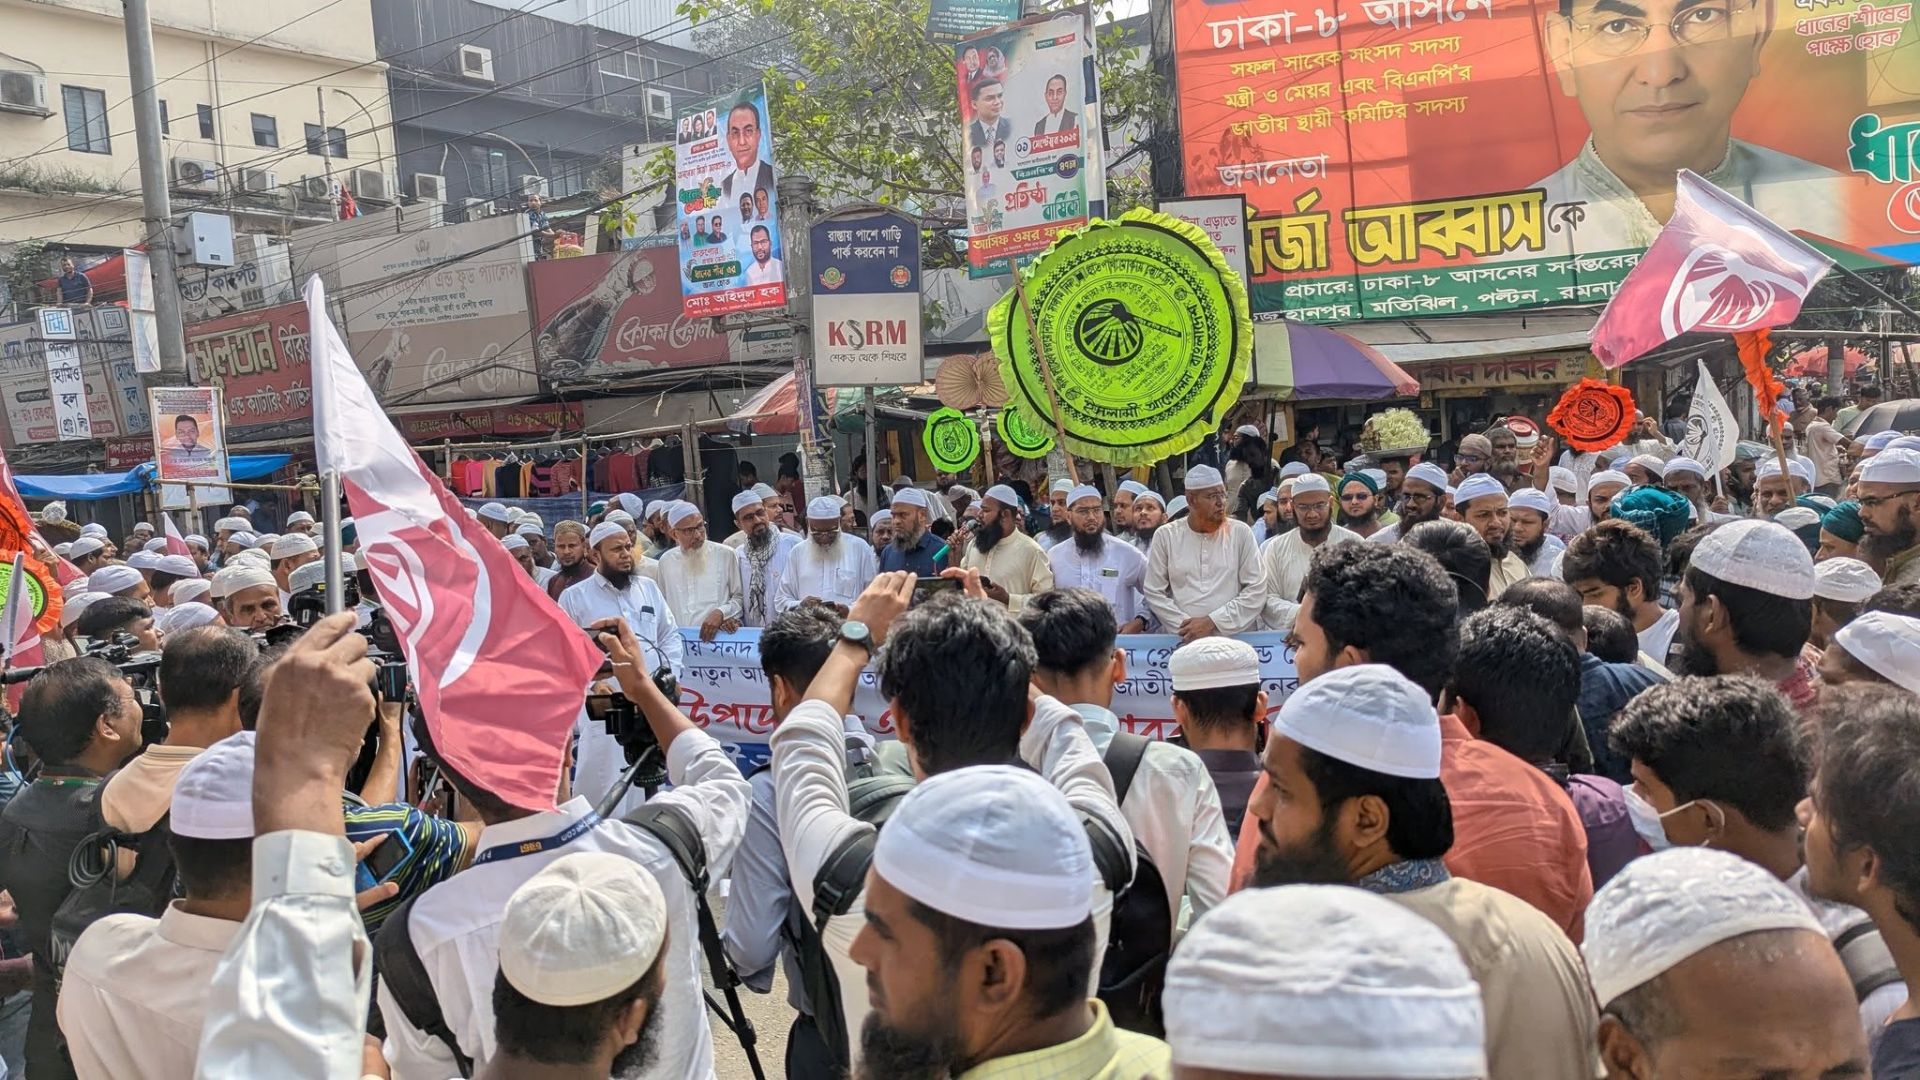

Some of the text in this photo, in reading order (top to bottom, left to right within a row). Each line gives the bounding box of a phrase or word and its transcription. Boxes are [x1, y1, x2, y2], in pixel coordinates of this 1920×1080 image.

[1207, 8, 1347, 50] ঢাকা-৮
[1795, 12, 1851, 36] ধানের
[1852, 4, 1912, 27] শীষের
[1855, 28, 1902, 50] হোক
[1229, 35, 1462, 80] সফল সাবেক সংসদ সদস্য
[1263, 89, 1278, 103] ও
[1285, 81, 1331, 102] মেয়র
[1338, 77, 1376, 96] এবং
[1231, 115, 1288, 139] জাতীয়
[1341, 99, 1407, 124] কমিটির
[1413, 95, 1468, 117] সদস্য
[1218, 152, 1330, 189] জননেতা
[856, 229, 878, 242] পাশে
[881, 225, 902, 243] গাড়ি
[1204, 214, 1238, 229] এড়াতে
[1343, 187, 1547, 267] আব্বাস
[1548, 201, 1587, 234] কে
[832, 244, 899, 260] পার্ক করবেন না
[972, 234, 1010, 250] আসিফ
[1013, 229, 1040, 242] ওমর
[1363, 273, 1440, 294] ঢাকা-৮
[1449, 264, 1540, 286] আসনের
[686, 296, 710, 308] মোঃ
[760, 286, 781, 298] হক
[829, 319, 907, 350] KSRM
[1080, 395, 1141, 418] ইসলামী
[1144, 369, 1195, 414] আন্দোলন
[1185, 302, 1204, 368] বাংলাদেশ
[710, 641, 754, 657] সনদ
[689, 666, 733, 688] নতুন
